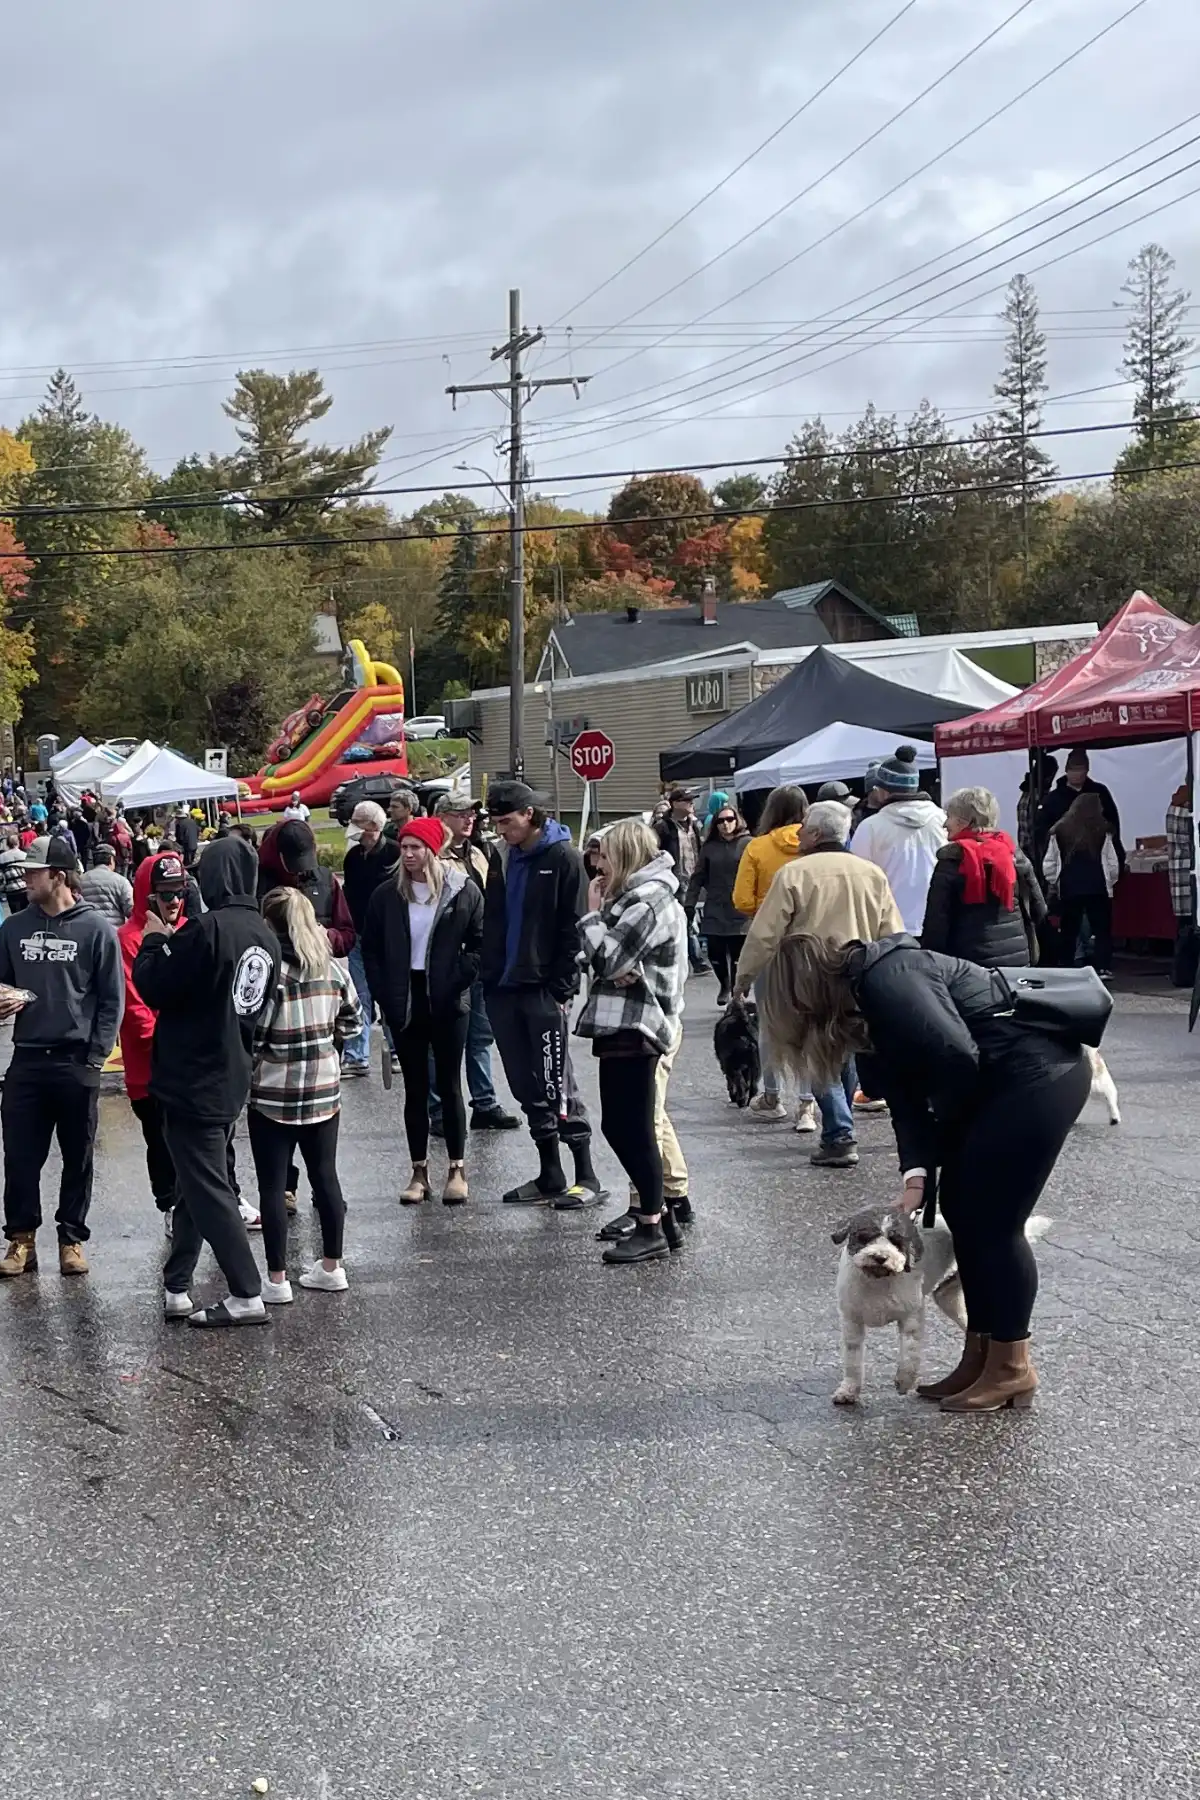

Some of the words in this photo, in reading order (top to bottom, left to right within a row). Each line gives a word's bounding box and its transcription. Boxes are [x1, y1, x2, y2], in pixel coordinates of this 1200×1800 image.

[690, 679, 720, 706] LCBO
[574, 745, 611, 767] STOP
[22, 950, 47, 961] 1ST
[47, 950, 76, 962] GEN
